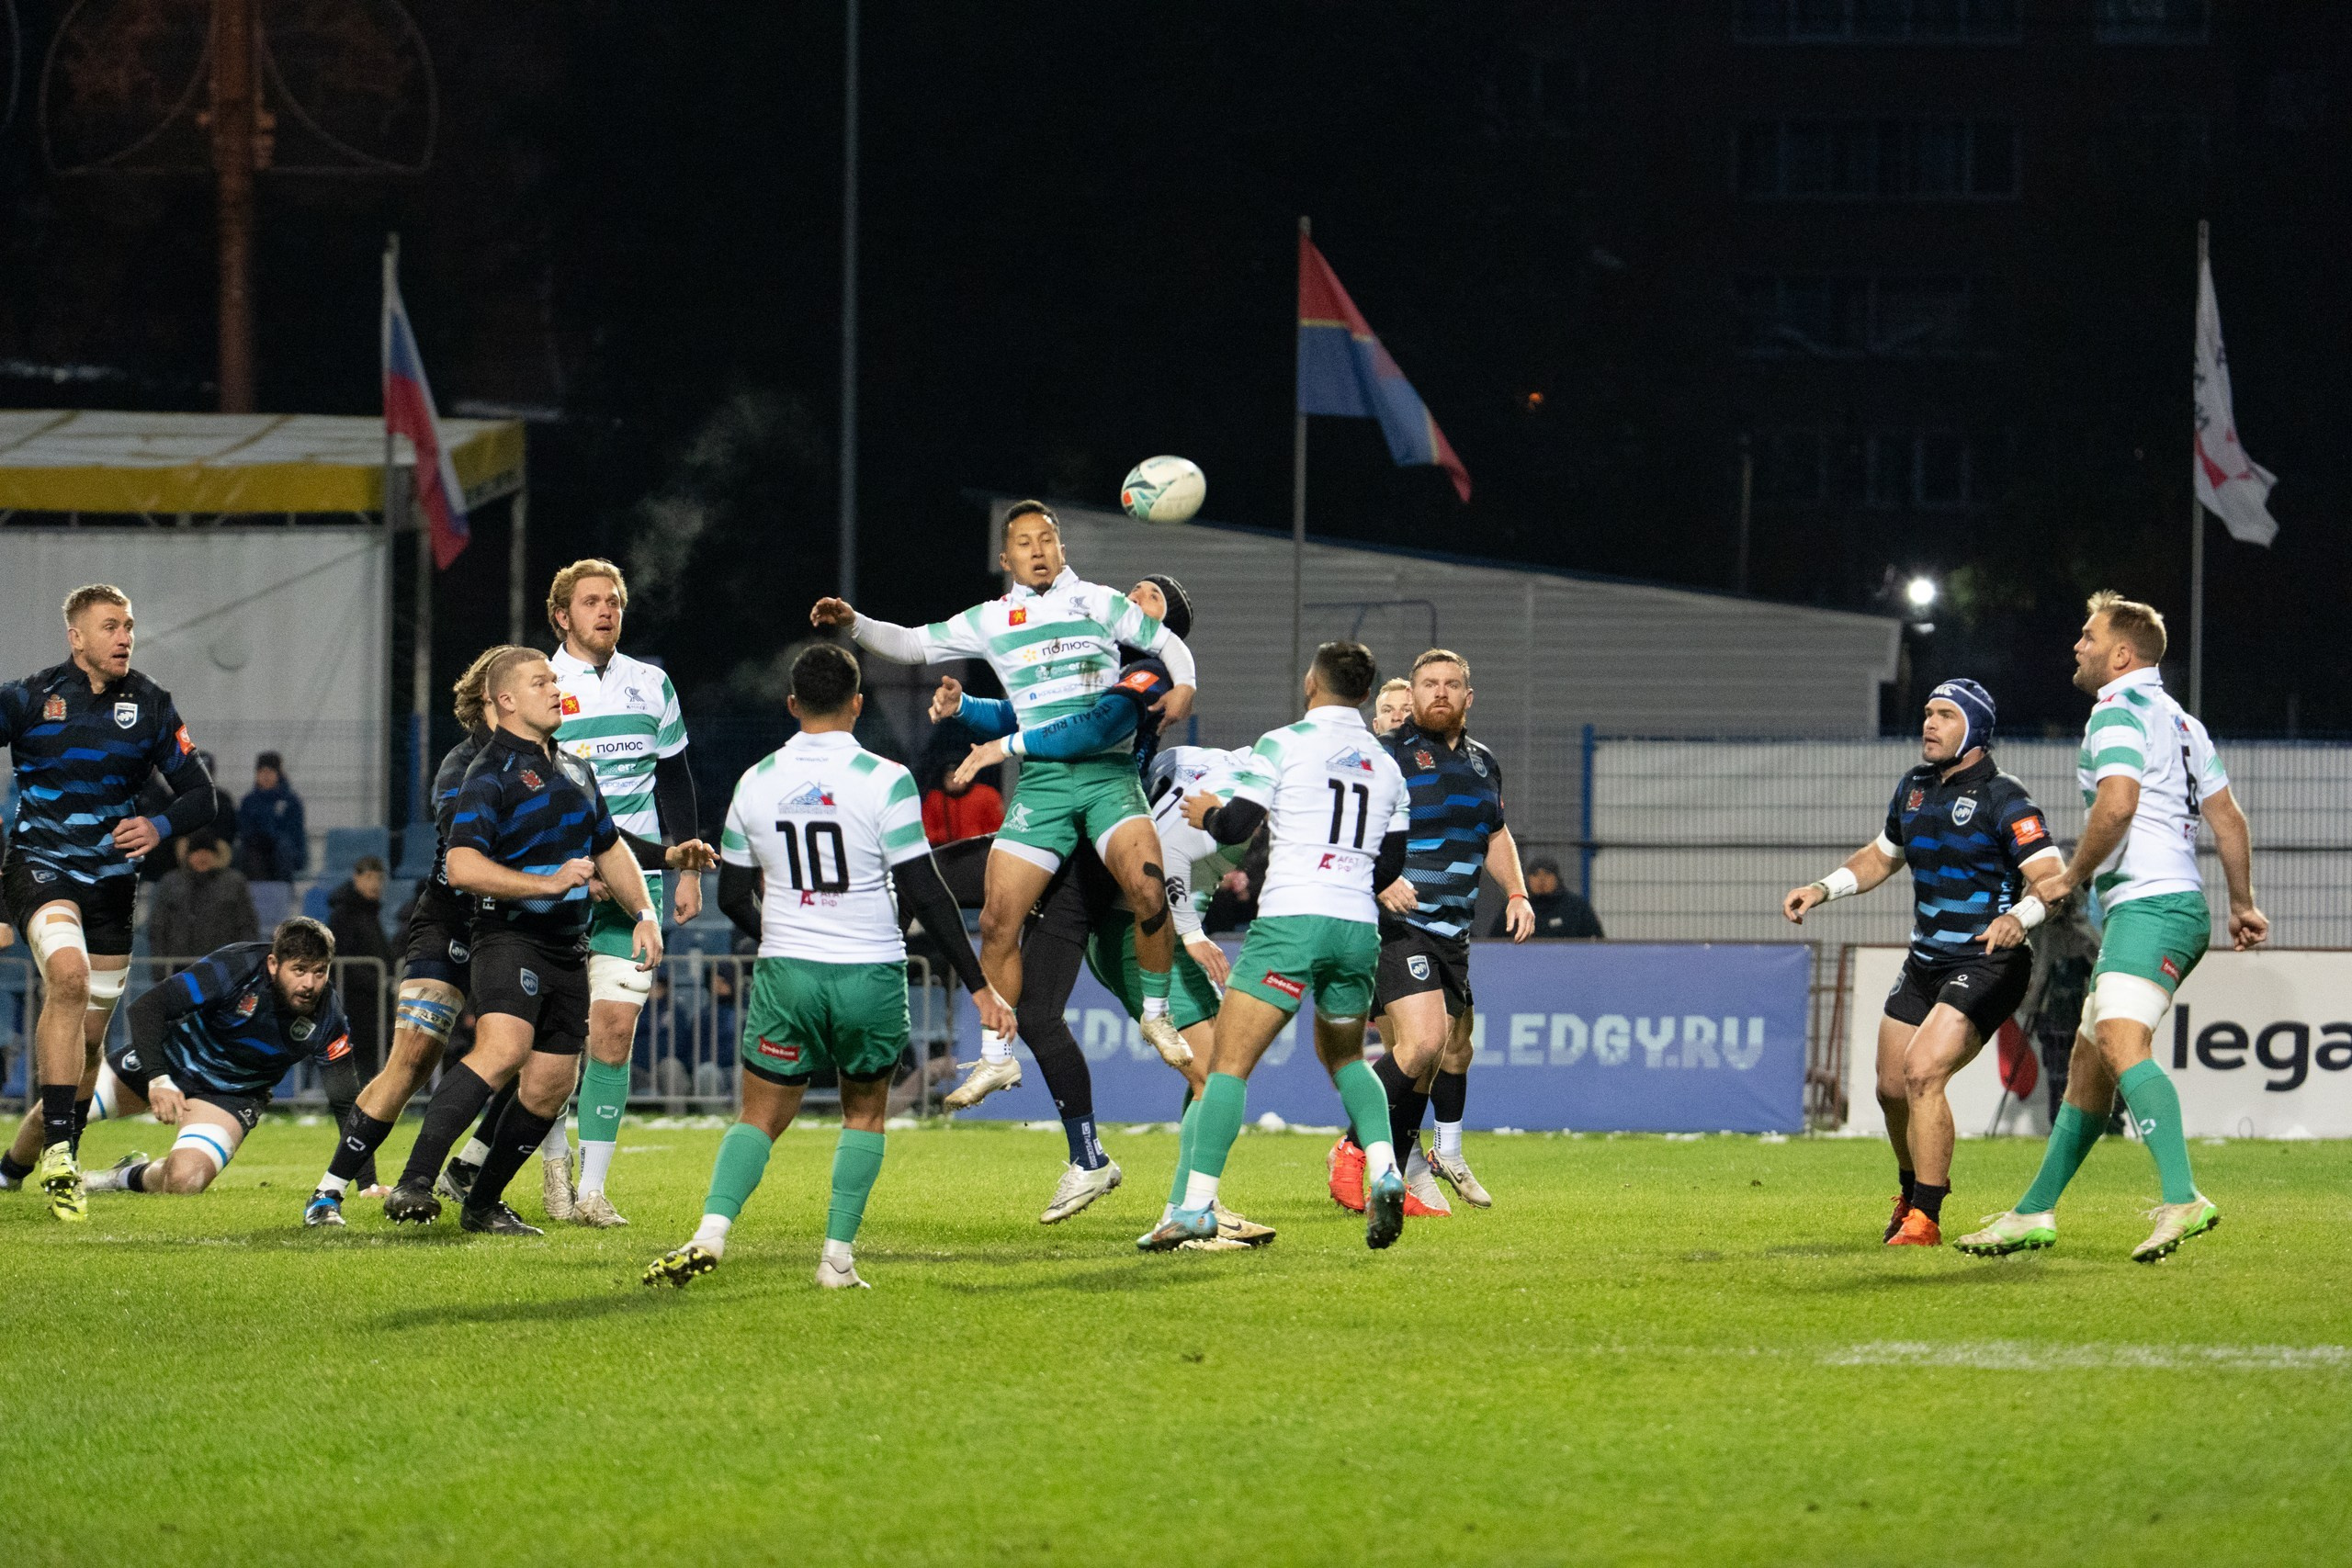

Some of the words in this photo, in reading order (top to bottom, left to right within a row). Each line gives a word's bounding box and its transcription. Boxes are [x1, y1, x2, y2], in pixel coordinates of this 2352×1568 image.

[1042, 640, 1091, 656] ПОЛЮС
[596, 741, 643, 753] ПОЛЮС
[1329, 778, 1369, 849] 11
[775, 820, 850, 893] 10
[1472, 1012, 1764, 1070] LEDGY.RU
[2173, 1003, 2352, 1092] lega
